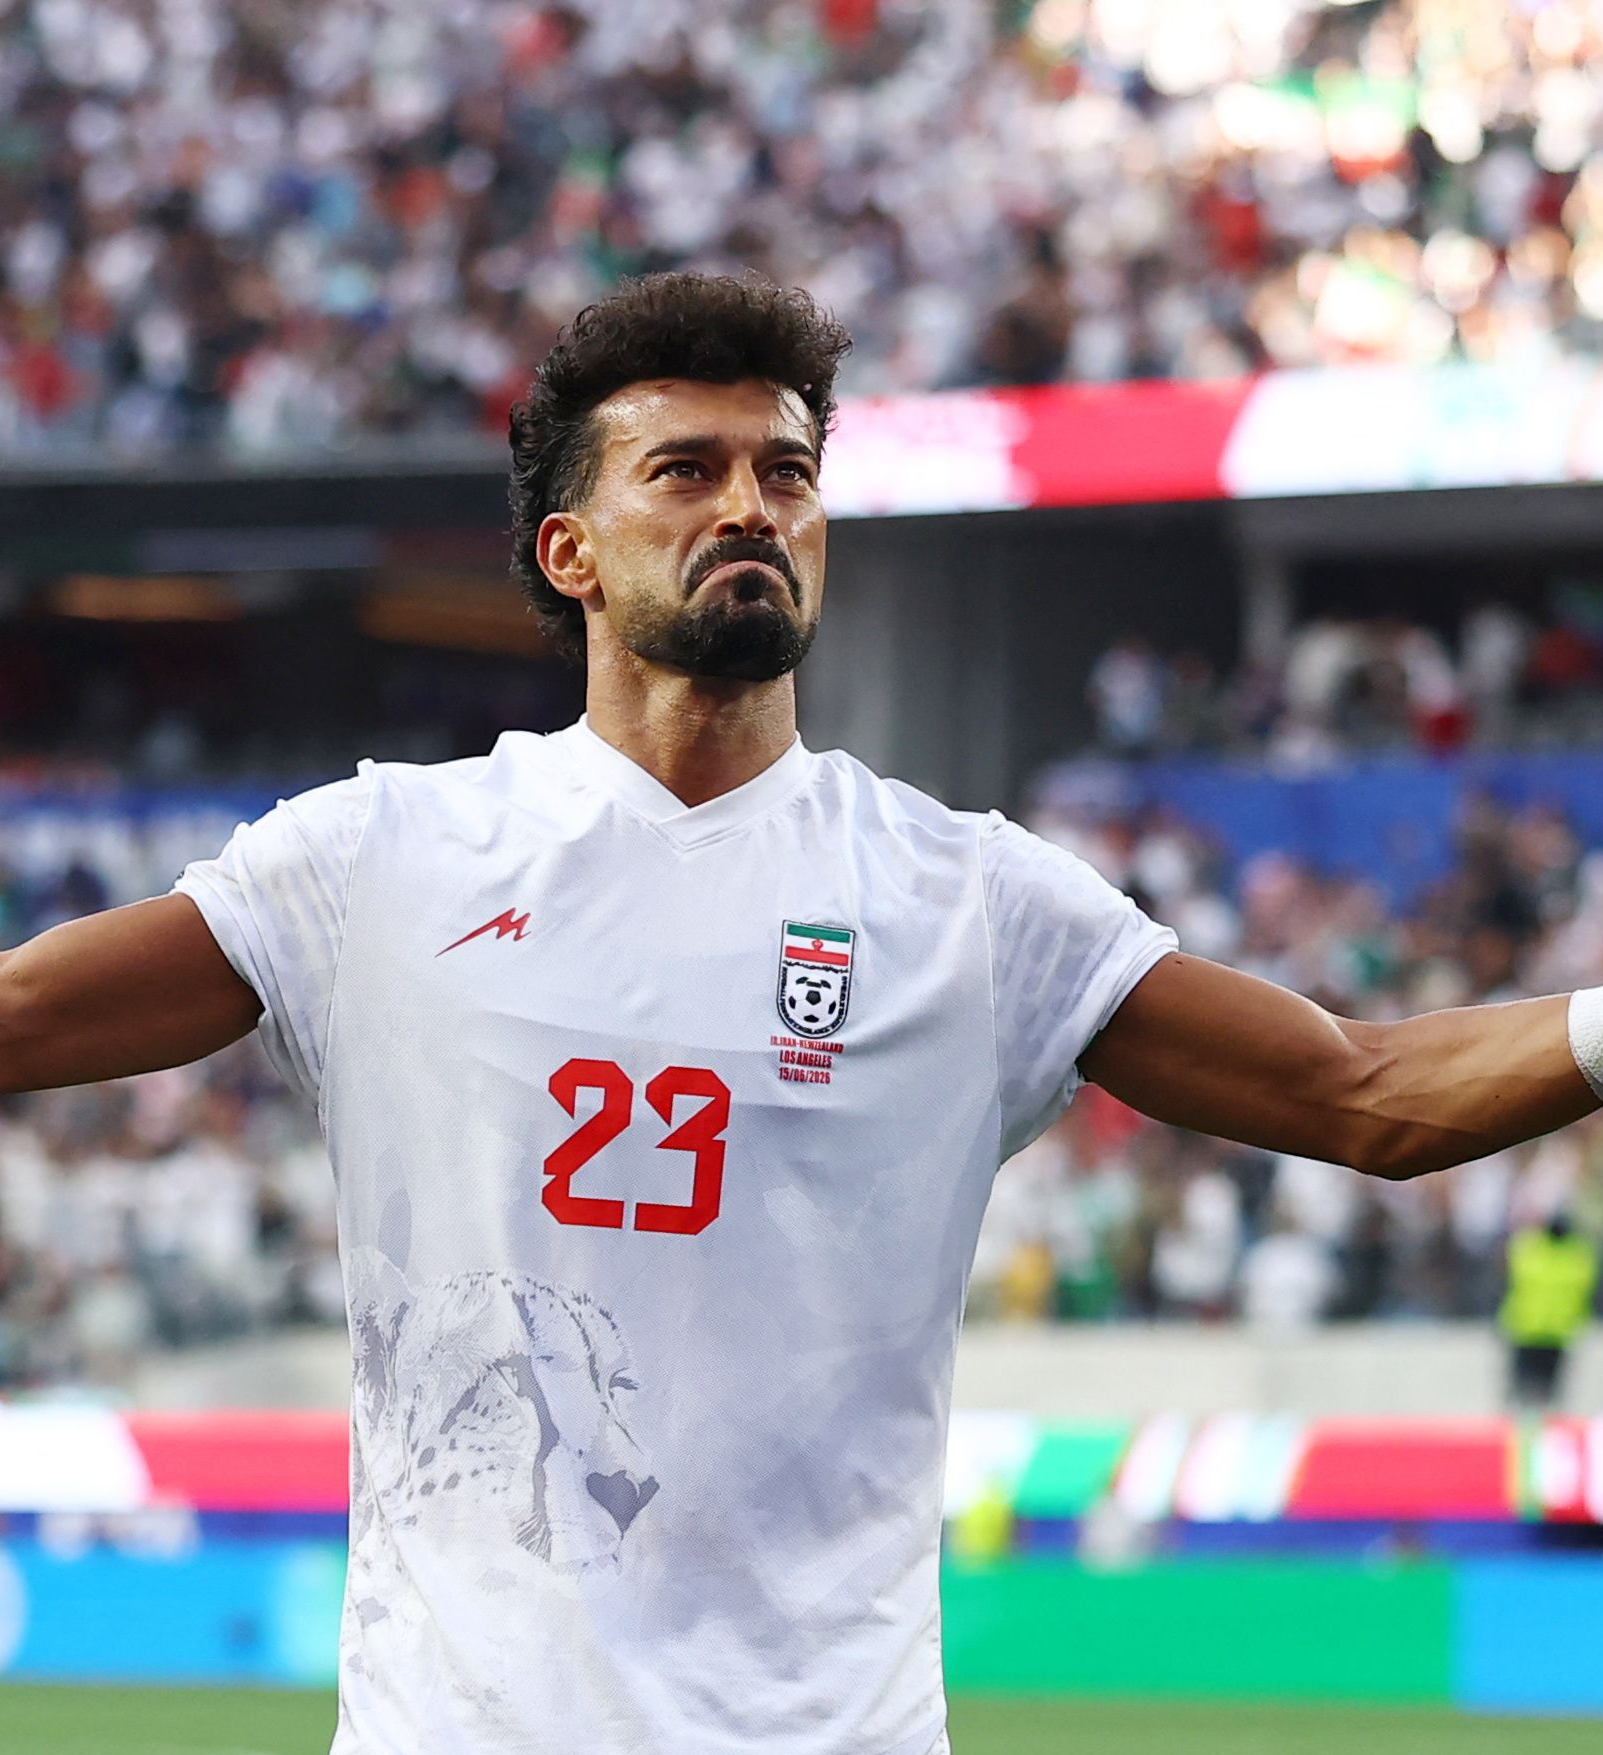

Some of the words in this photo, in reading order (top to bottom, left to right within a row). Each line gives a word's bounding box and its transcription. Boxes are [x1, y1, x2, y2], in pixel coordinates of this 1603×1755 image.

[779, 1050, 795, 1064] LOS
[796, 1052, 832, 1068] ANGELES
[779, 1067, 830, 1084] 15/06/2026
[542, 1058, 731, 1235] 23
